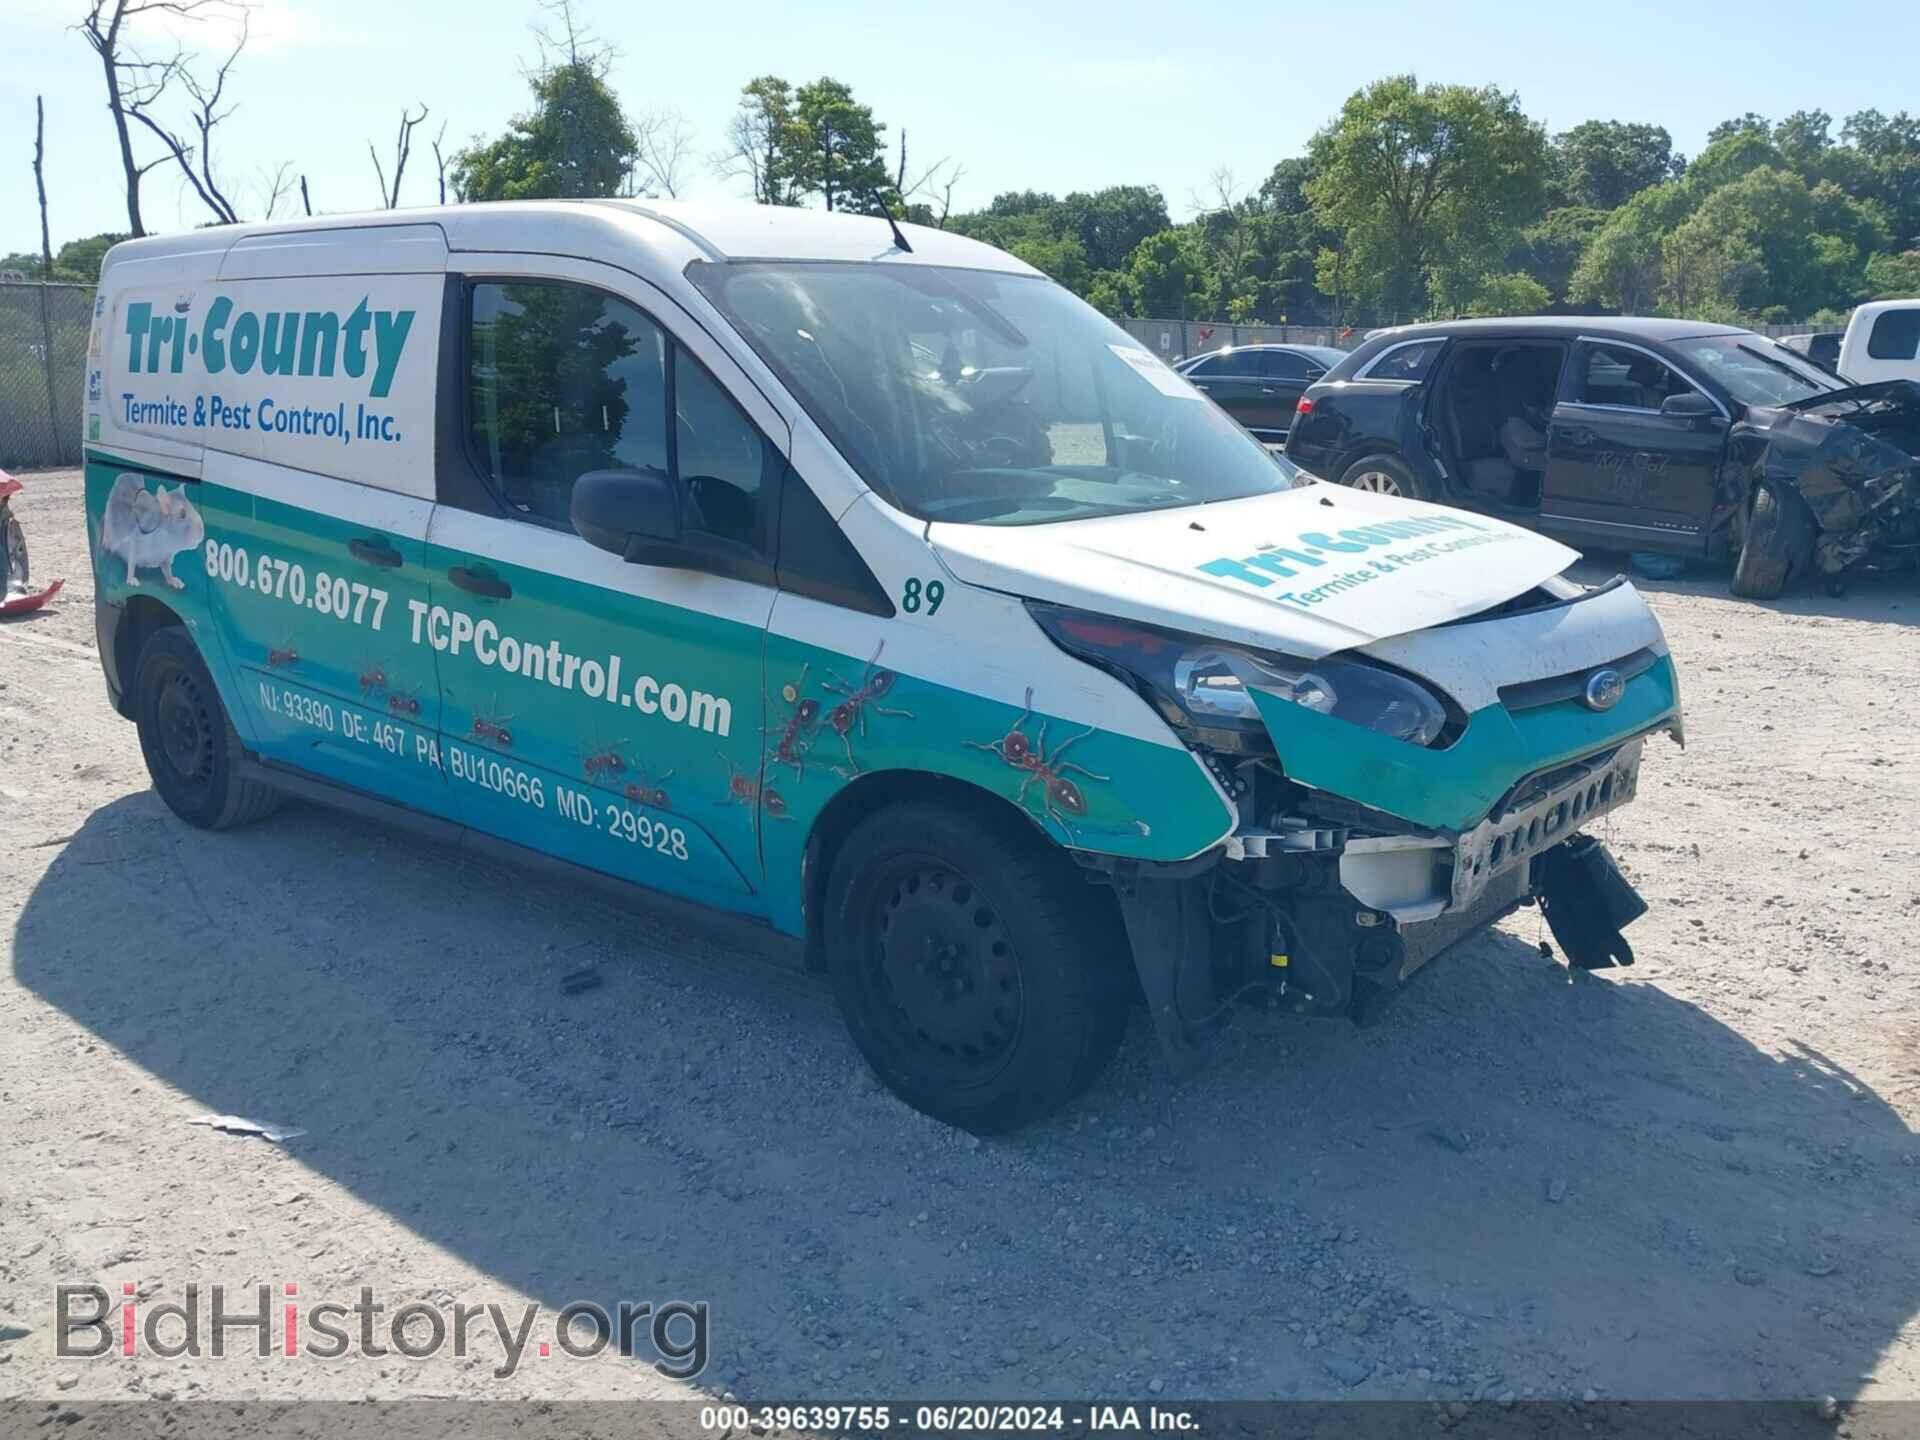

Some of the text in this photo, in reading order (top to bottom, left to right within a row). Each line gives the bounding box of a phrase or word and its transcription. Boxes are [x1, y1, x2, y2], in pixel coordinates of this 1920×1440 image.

[122, 393, 188, 427] Termite
[193, 395, 207, 427] &
[210, 395, 251, 430] Pest
[257, 398, 351, 445] Control,
[356, 404, 401, 442] Inc.
[902, 577, 945, 616] 89
[1277, 569, 1379, 607] Termite
[1367, 560, 1399, 573] &
[205, 538, 733, 738] 800.670.8077 TCPControl.com
[283, 690, 334, 732] 93390
[342, 709, 369, 745] DE:
[373, 720, 405, 757] 467
[416, 734, 446, 771] PA:
[450, 746, 545, 809] BU10666
[557, 785, 601, 829] MD:
[606, 804, 689, 861] 29928
